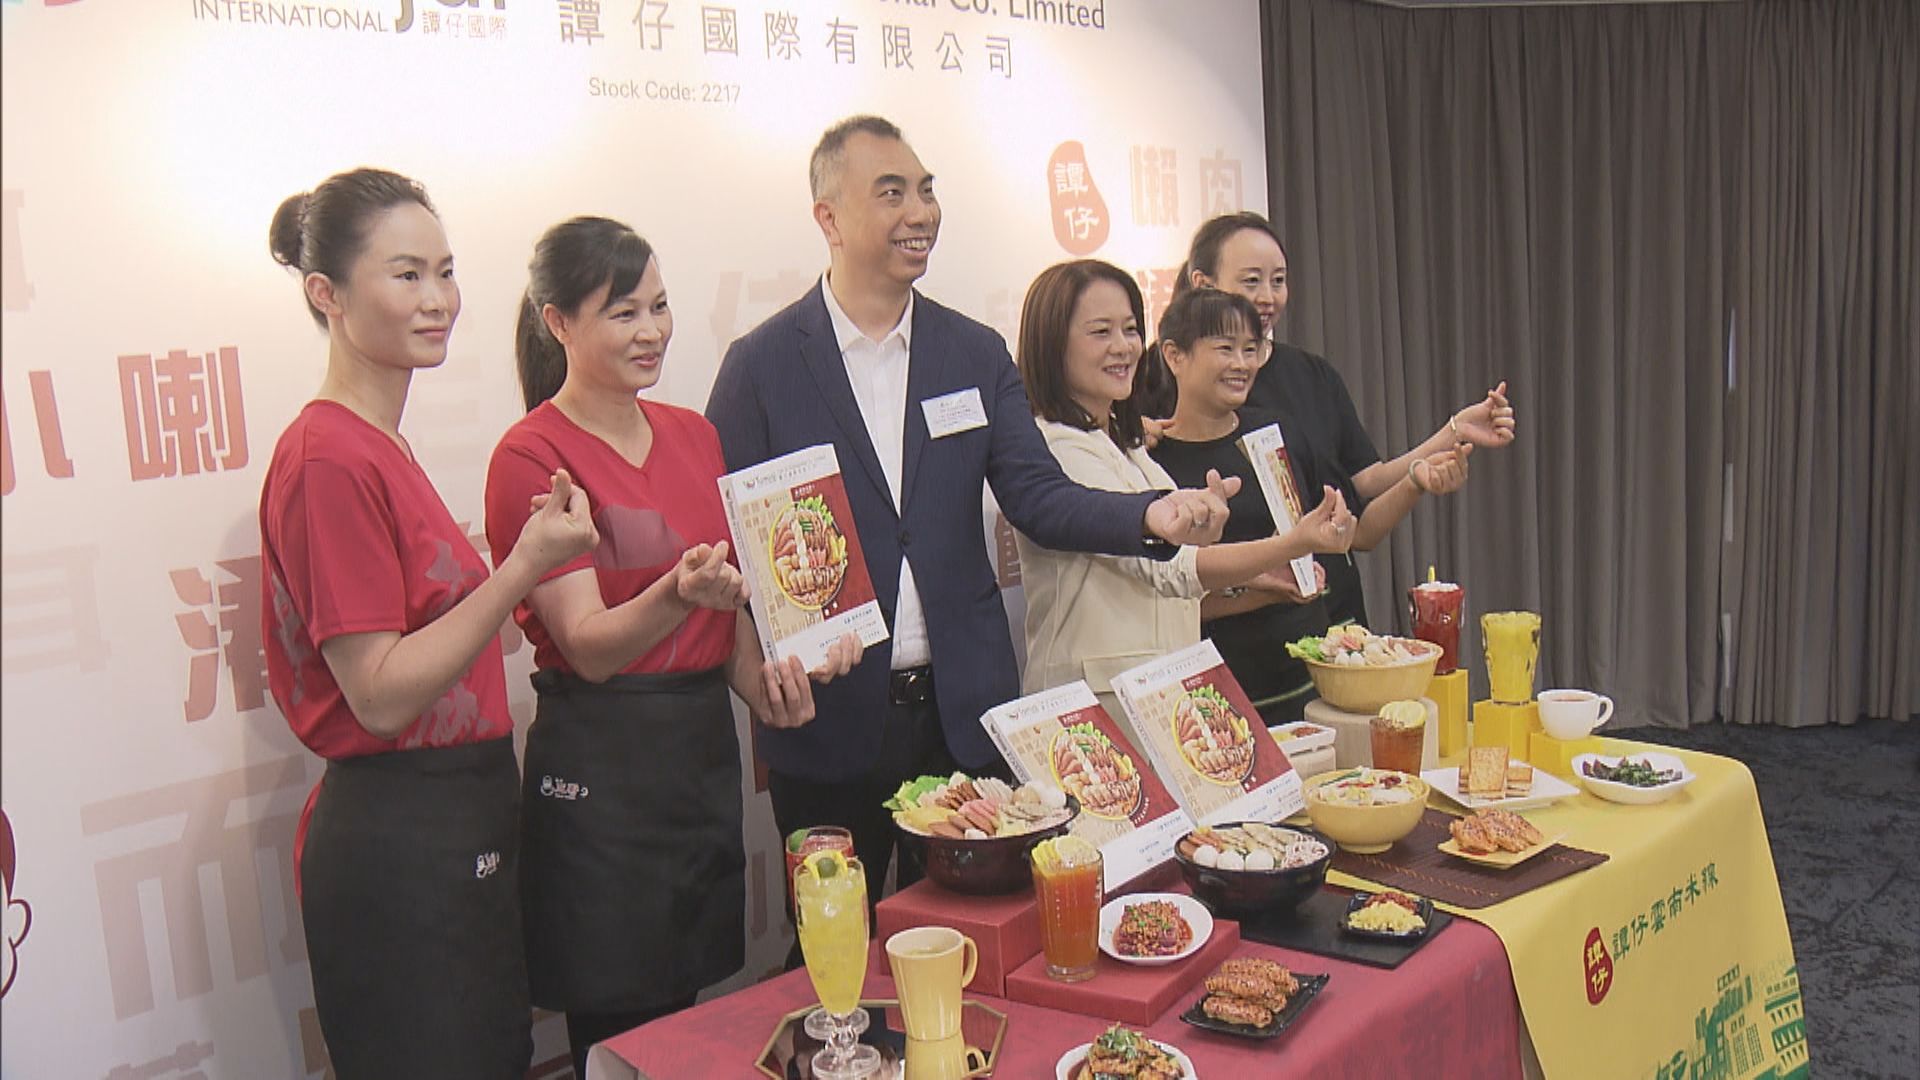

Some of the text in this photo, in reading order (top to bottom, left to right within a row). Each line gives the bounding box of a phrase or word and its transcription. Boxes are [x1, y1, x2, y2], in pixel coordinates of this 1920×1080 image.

[192, 0, 388, 32] INTERNATIONAL
[423, 9, 508, 39] 譚仔國際
[1009, 0, 1105, 29] Limited
[558, 0, 1012, 79] 譚仔國際有限公司
[588, 77, 741, 103] Stock Code: 2217
[1055, 162, 1099, 240] 譚仔
